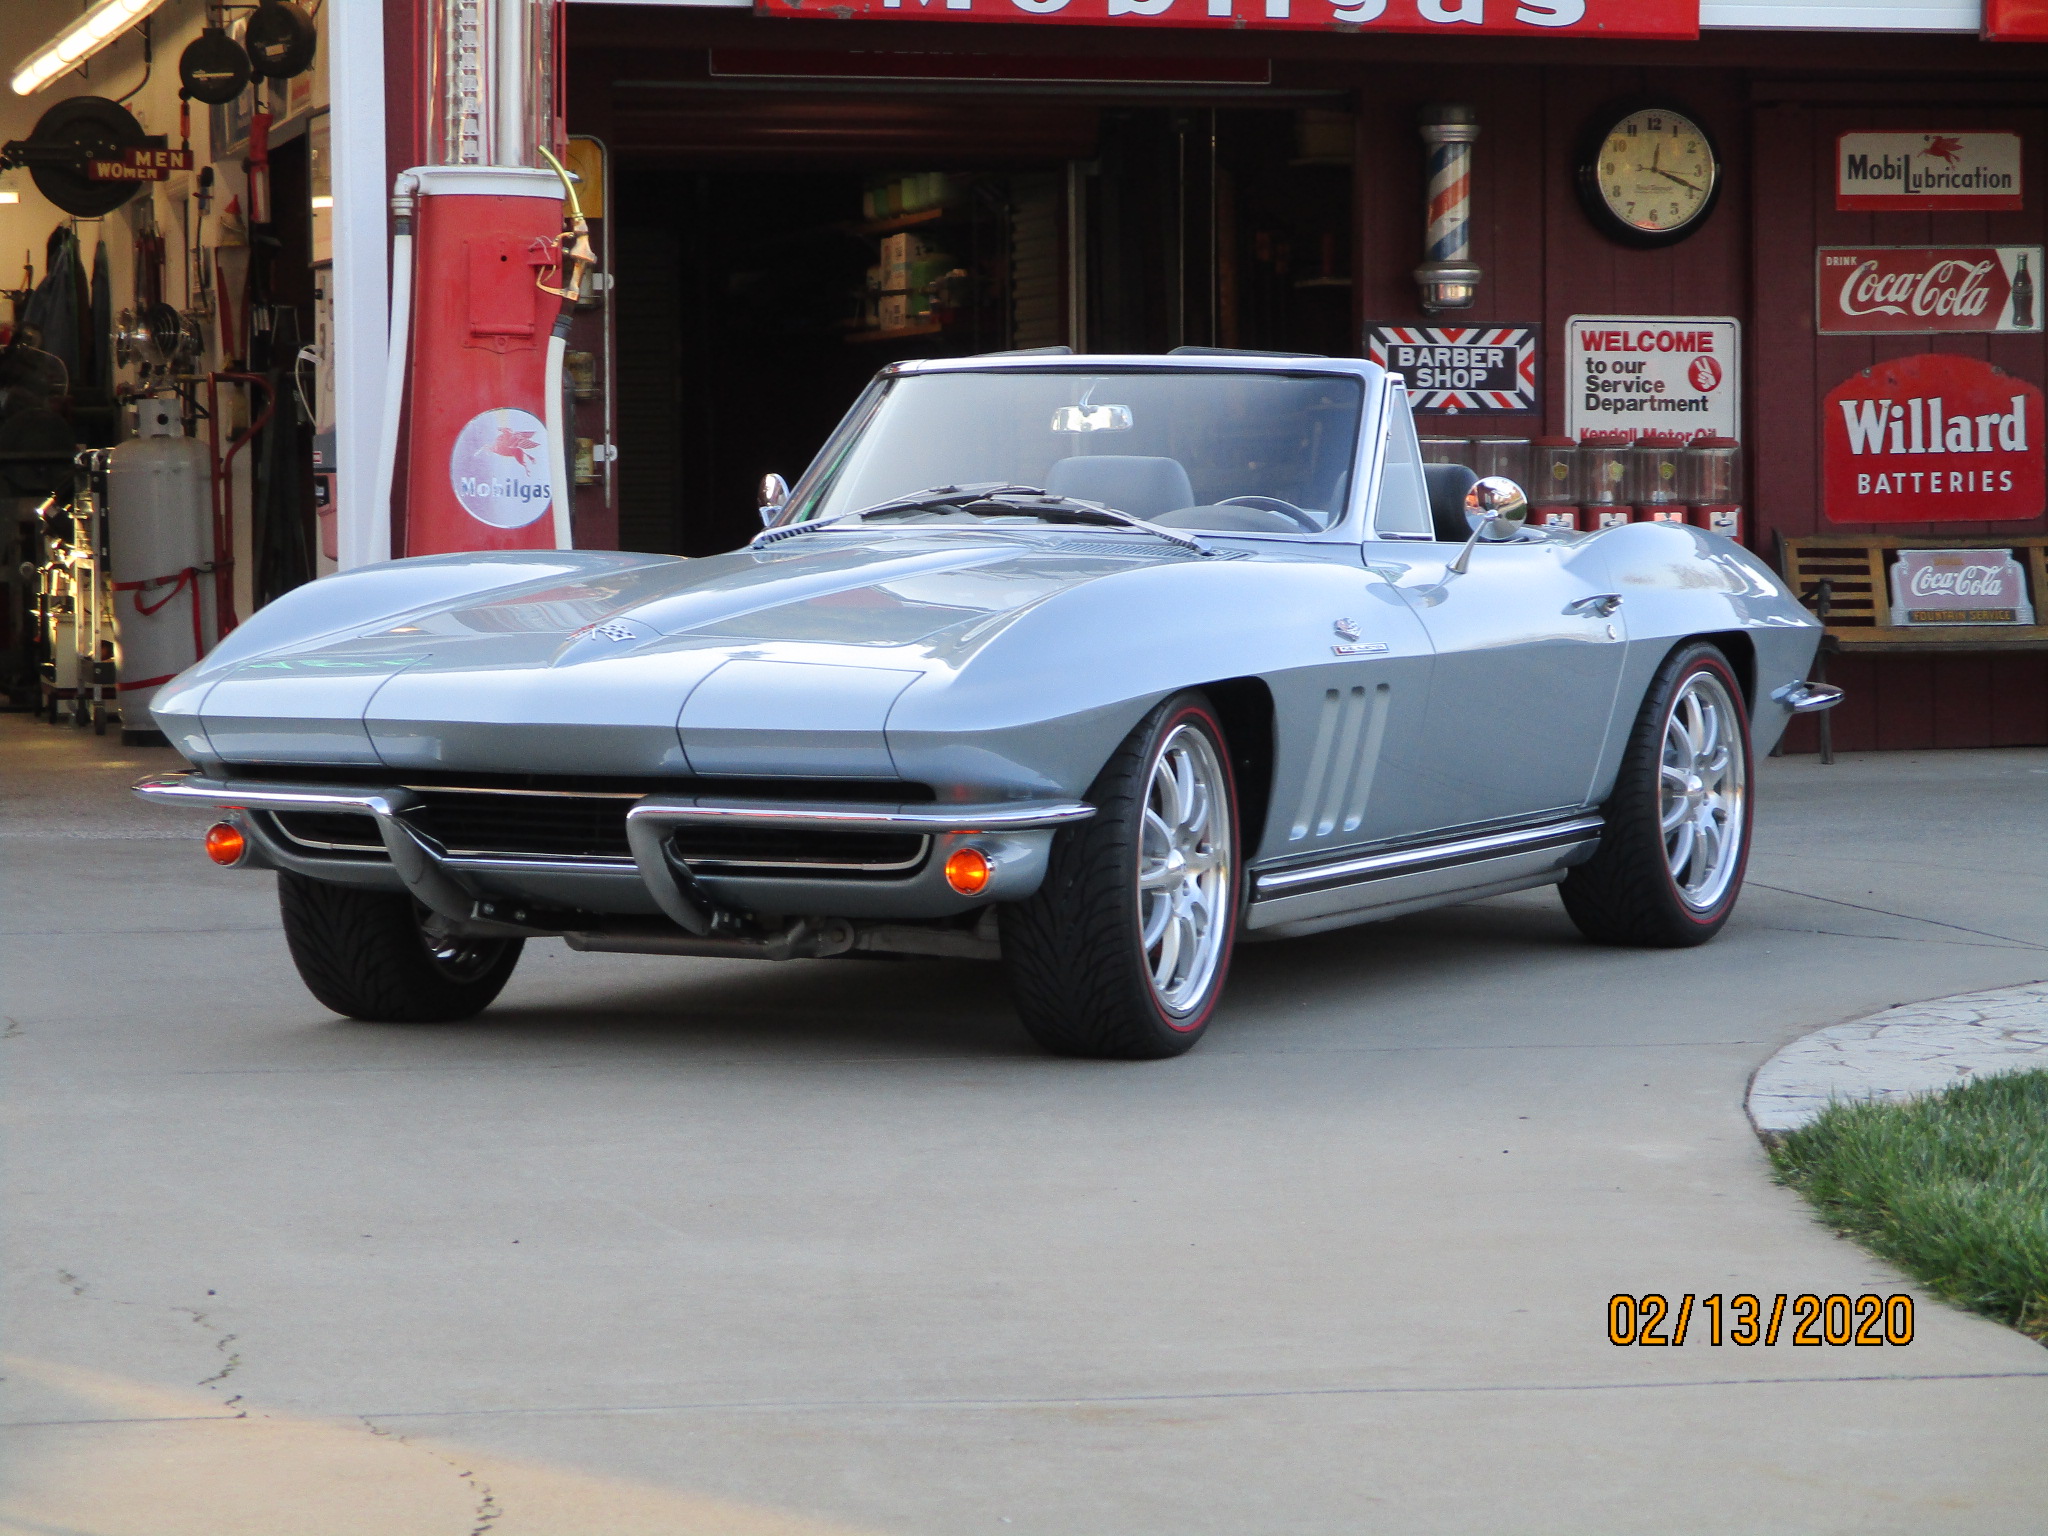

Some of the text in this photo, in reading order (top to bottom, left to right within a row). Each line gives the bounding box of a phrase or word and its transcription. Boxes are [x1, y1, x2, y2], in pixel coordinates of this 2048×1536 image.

[1647, 117, 1661, 131] 12
[1673, 125, 1678, 138] 1
[1612, 139, 1627, 153] 10
[1686, 140, 1697, 153] 2
[135, 151, 184, 168] MEN
[97, 162, 157, 179] WOMEN
[1606, 162, 1615, 175] 9
[1694, 163, 1702, 177] 3
[1847, 153, 2013, 194] MobiLubrication
[1612, 185, 1621, 198] 8
[1626, 201, 1636, 214] 7
[1649, 208, 1658, 221] 6
[1670, 202, 1679, 215] 5
[1826, 256, 1858, 266] DRINK
[1839, 259, 1996, 317] Coca-Cola
[1580, 330, 1714, 353] WELCOME
[1398, 347, 1505, 368] BARBER
[1585, 357, 1646, 374] to our
[1416, 367, 1488, 388] SHOP
[1585, 374, 1666, 393] Service
[1585, 393, 1709, 414] Department
[1839, 394, 2029, 455] Willard
[460, 476, 551, 503] Mobilgas
[1857, 470, 2013, 495] BATTERIES
[1911, 565, 2004, 597] Coca-Cola
